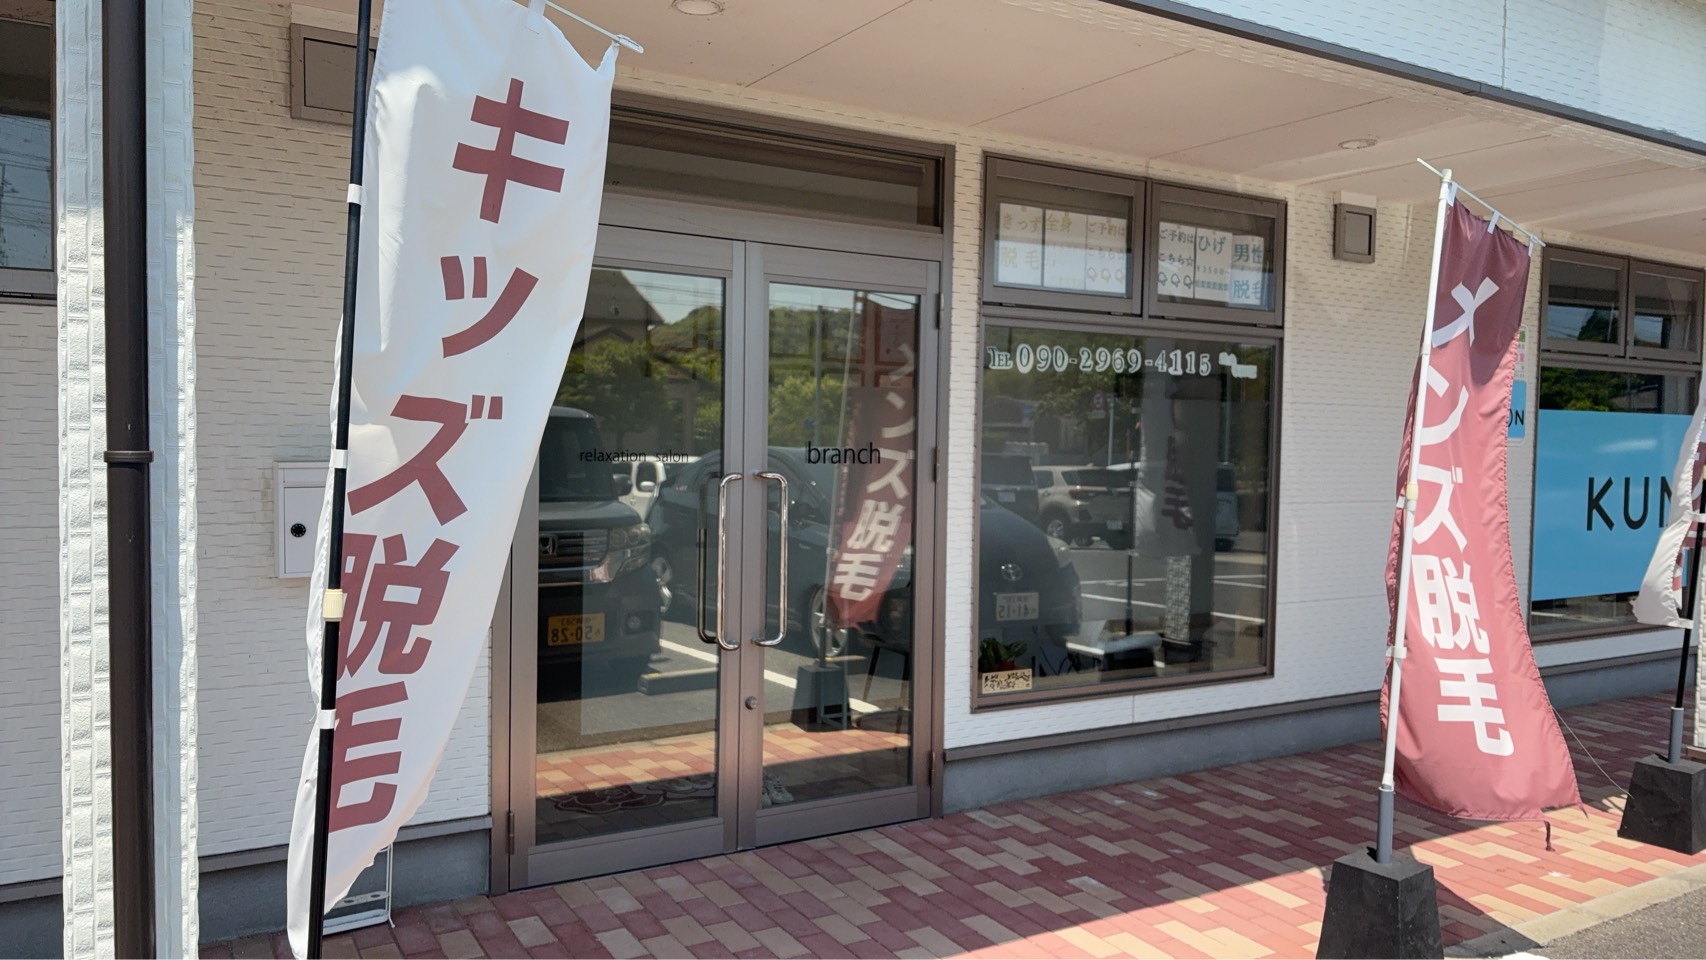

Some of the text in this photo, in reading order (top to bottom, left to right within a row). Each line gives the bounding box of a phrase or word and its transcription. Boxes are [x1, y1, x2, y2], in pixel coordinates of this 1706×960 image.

[1159, 229, 1194, 245] ご予約は
[1198, 235, 1227, 255] ひげ
[1233, 243, 1263, 264] 男性
[1233, 279, 1262, 300] 脱毛
[1016, 343, 1212, 377] 090-2969-4115
[329, 77, 570, 833] キッズ脱毛
[579, 448, 689, 464] relaxation salon
[807, 442, 881, 465] branch
[1411, 277, 1515, 757] メンズ脱毛
